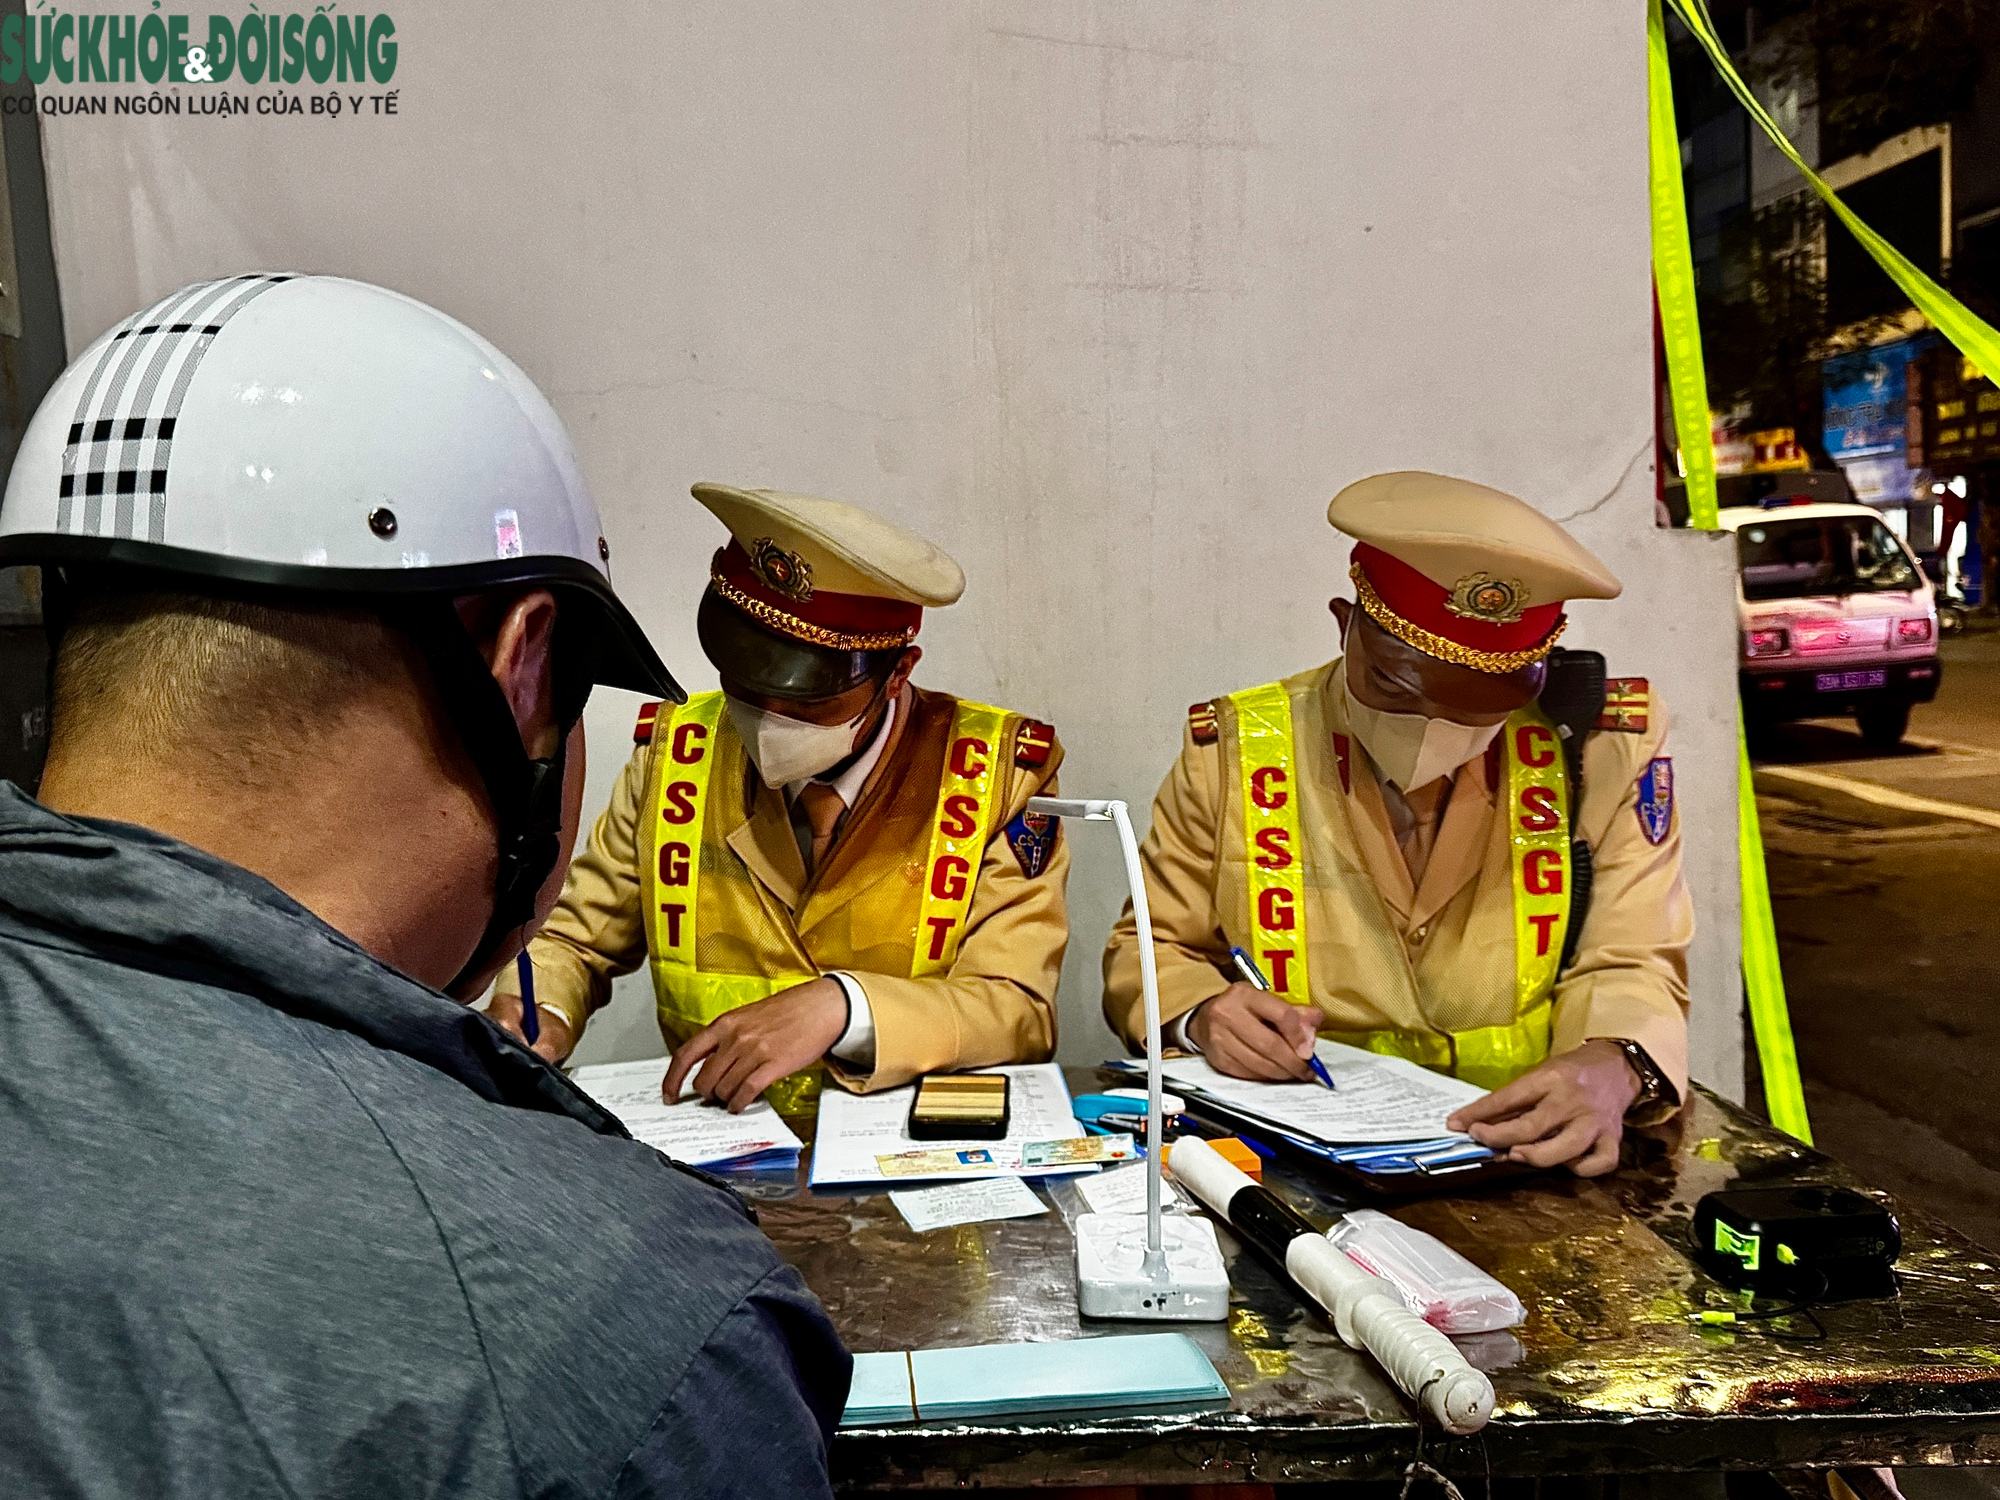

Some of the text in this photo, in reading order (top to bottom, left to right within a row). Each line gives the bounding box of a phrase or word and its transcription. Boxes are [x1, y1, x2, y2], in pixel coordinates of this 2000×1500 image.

[660, 723, 707, 948] CSGT
[927, 737, 988, 961] CSGT
[1251, 767, 1295, 994] CSGT
[1516, 725, 1563, 957] CSGT
